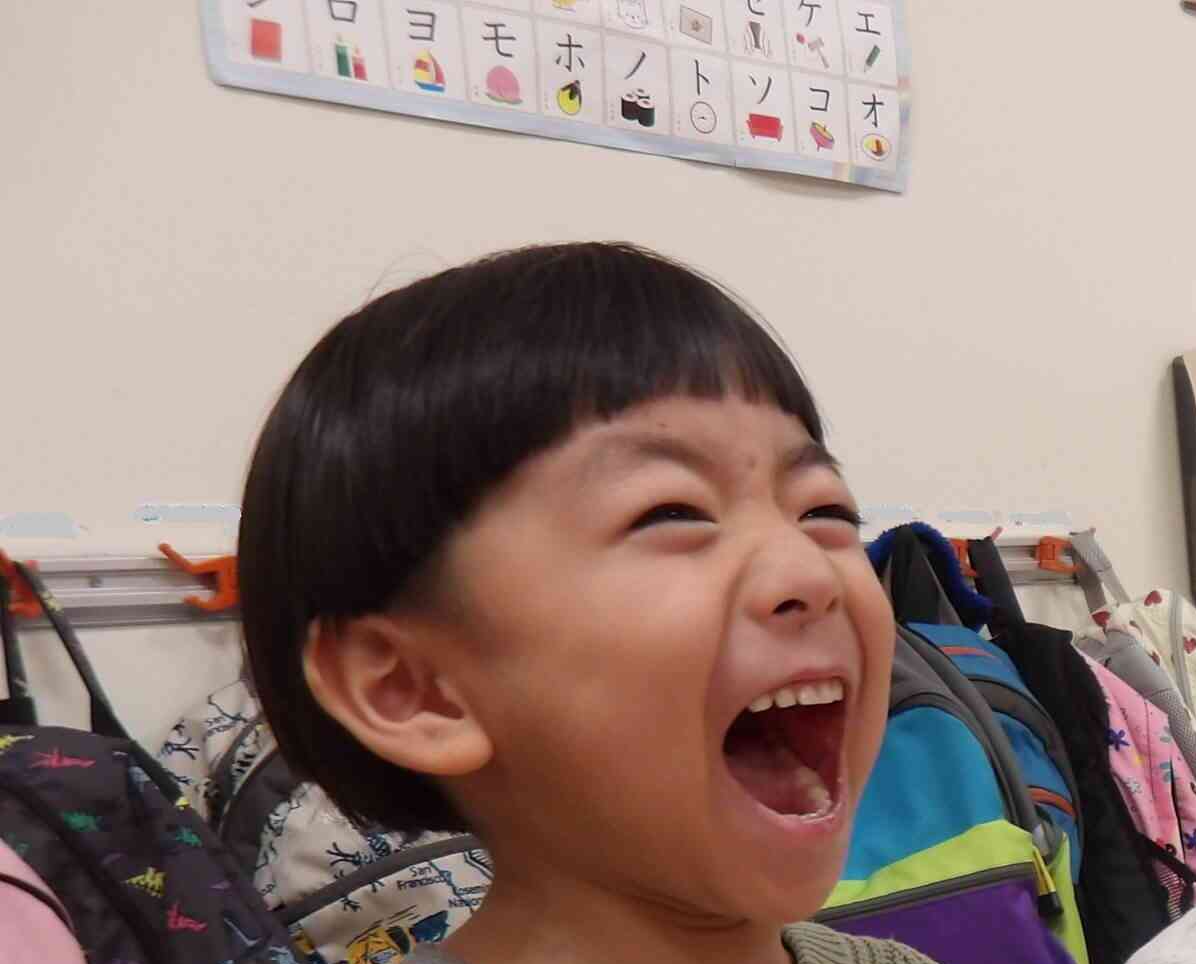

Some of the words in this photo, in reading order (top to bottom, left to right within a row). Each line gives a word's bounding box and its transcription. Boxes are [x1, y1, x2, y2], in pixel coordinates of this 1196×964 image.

[855, 11, 881, 36] エ
[406, 9, 436, 42] ヨ
[482, 22, 517, 57] モ
[555, 33, 585, 73] ホ
[624, 51, 647, 80] ノ
[694, 59, 711, 97] ト
[749, 74, 773, 105] ソ
[808, 87, 831, 112] コ
[861, 93, 885, 128] オ
[409, 866, 432, 877] San
